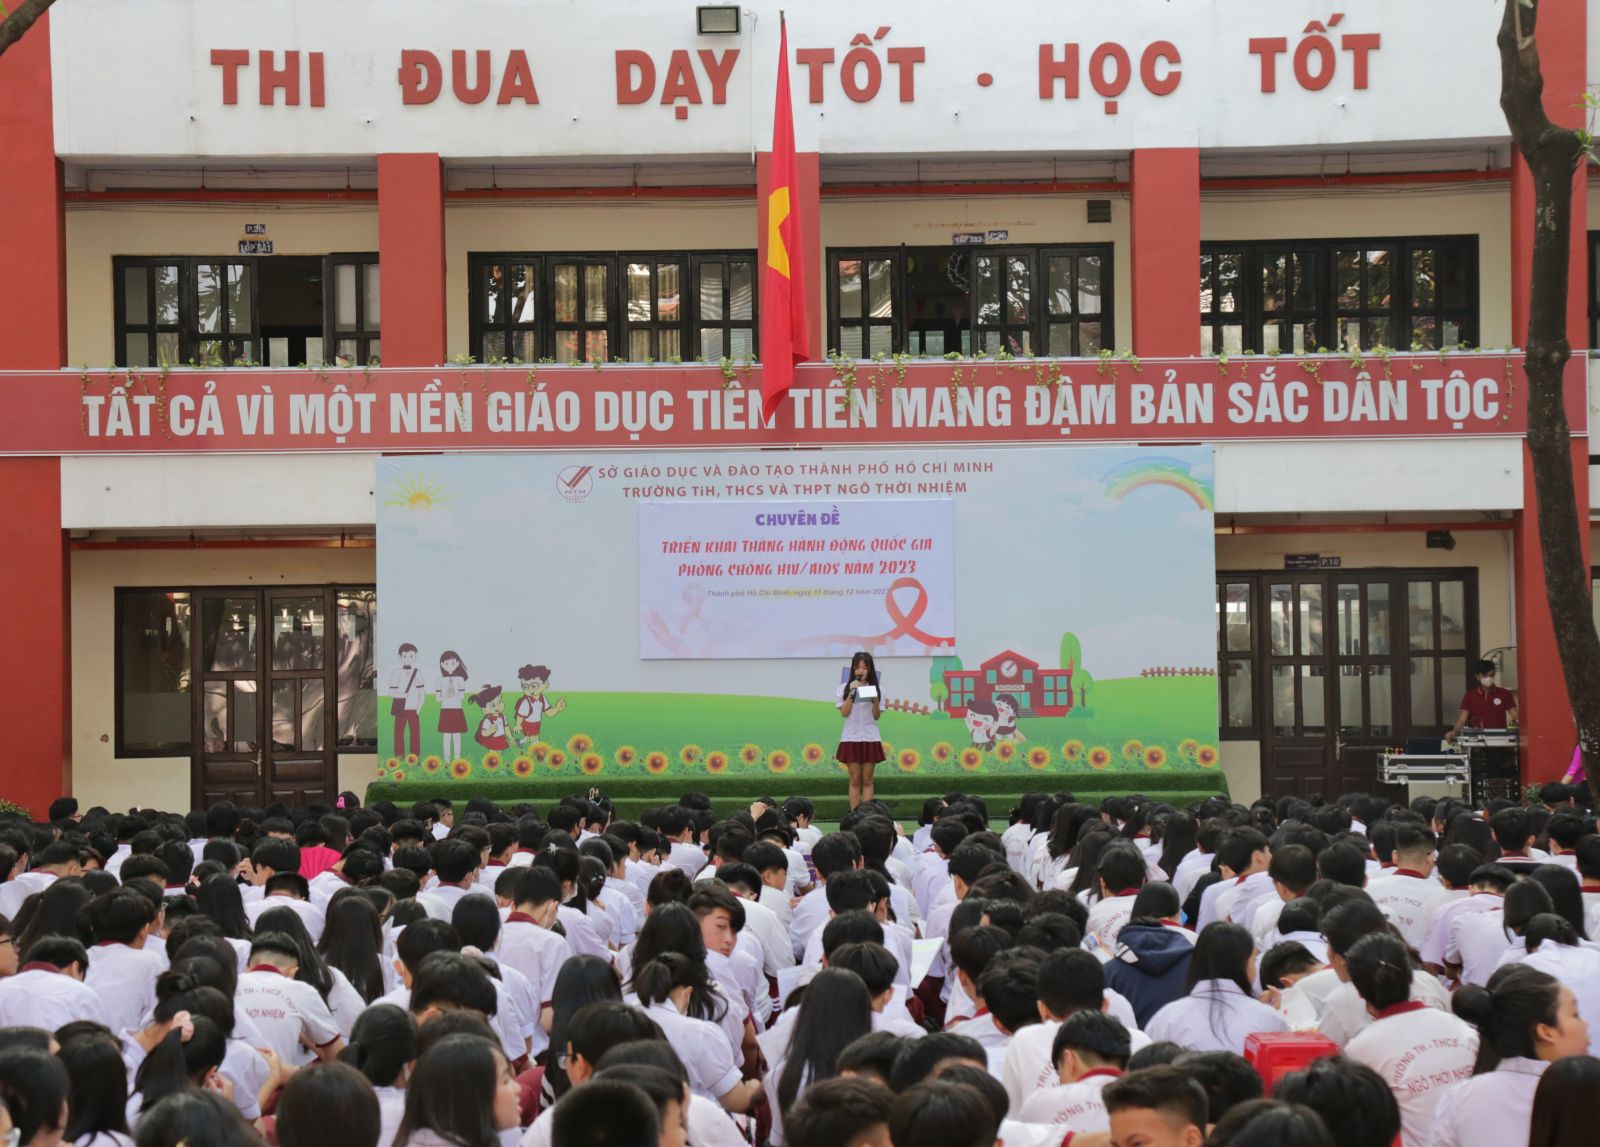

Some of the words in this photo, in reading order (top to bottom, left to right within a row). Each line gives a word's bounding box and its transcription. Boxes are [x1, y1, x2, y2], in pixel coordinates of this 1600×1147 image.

[211, 49, 324, 107] THI
[398, 49, 539, 105] ĐUA
[615, 49, 741, 119] DẠY
[797, 25, 925, 103] TỐT
[1038, 40, 1182, 115] HỌC
[1248, 13, 1381, 93] TỐT
[169, 380, 224, 436] CẢ
[237, 385, 274, 435] VÌ
[290, 384, 376, 443] MỘT
[390, 378, 472, 433] NỀN
[487, 382, 580, 432] GIÁO
[595, 390, 674, 441] DỤC
[687, 380, 775, 430] TIÊN
[891, 386, 1011, 428] MANG
[1024, 375, 1116, 434] ĐẬM
[1131, 369, 1213, 424] BẢN
[1228, 366, 1309, 423] SẮC
[1323, 371, 1407, 421] DÂN
[1421, 370, 1499, 430] TỘC
[624, 465, 661, 478] GIÁO
[667, 466, 698, 480] DỤC
[703, 464, 721, 476] VÀ
[728, 463, 760, 476] ĐÀO
[765, 464, 794, 478] TẠO
[799, 462, 852, 475] THÀNH
[858, 460, 889, 474] PHỐ
[922, 460, 947, 473] CHÍ
[953, 461, 993, 473] MINH
[622, 484, 686, 497] TRƯỜNG
[725, 484, 764, 496] THCS
[769, 482, 788, 495] VÀ
[793, 484, 832, 495] THPT
[837, 481, 870, 494] NGÔ
[875, 480, 911, 494] THỜI
[918, 480, 967, 496] NHIỆM
[755, 509, 817, 526] CHUYÊN
[820, 505, 840, 525] ĐỀ
[705, 540, 737, 553] KHAI
[829, 536, 866, 553] ĐỘNG
[911, 538, 932, 551] GIA
[777, 561, 840, 575] HIV/AIDS
[879, 559, 917, 574] 2023
[1413, 1043, 1428, 1055] TH
[1432, 1038, 1459, 1048] THCS
